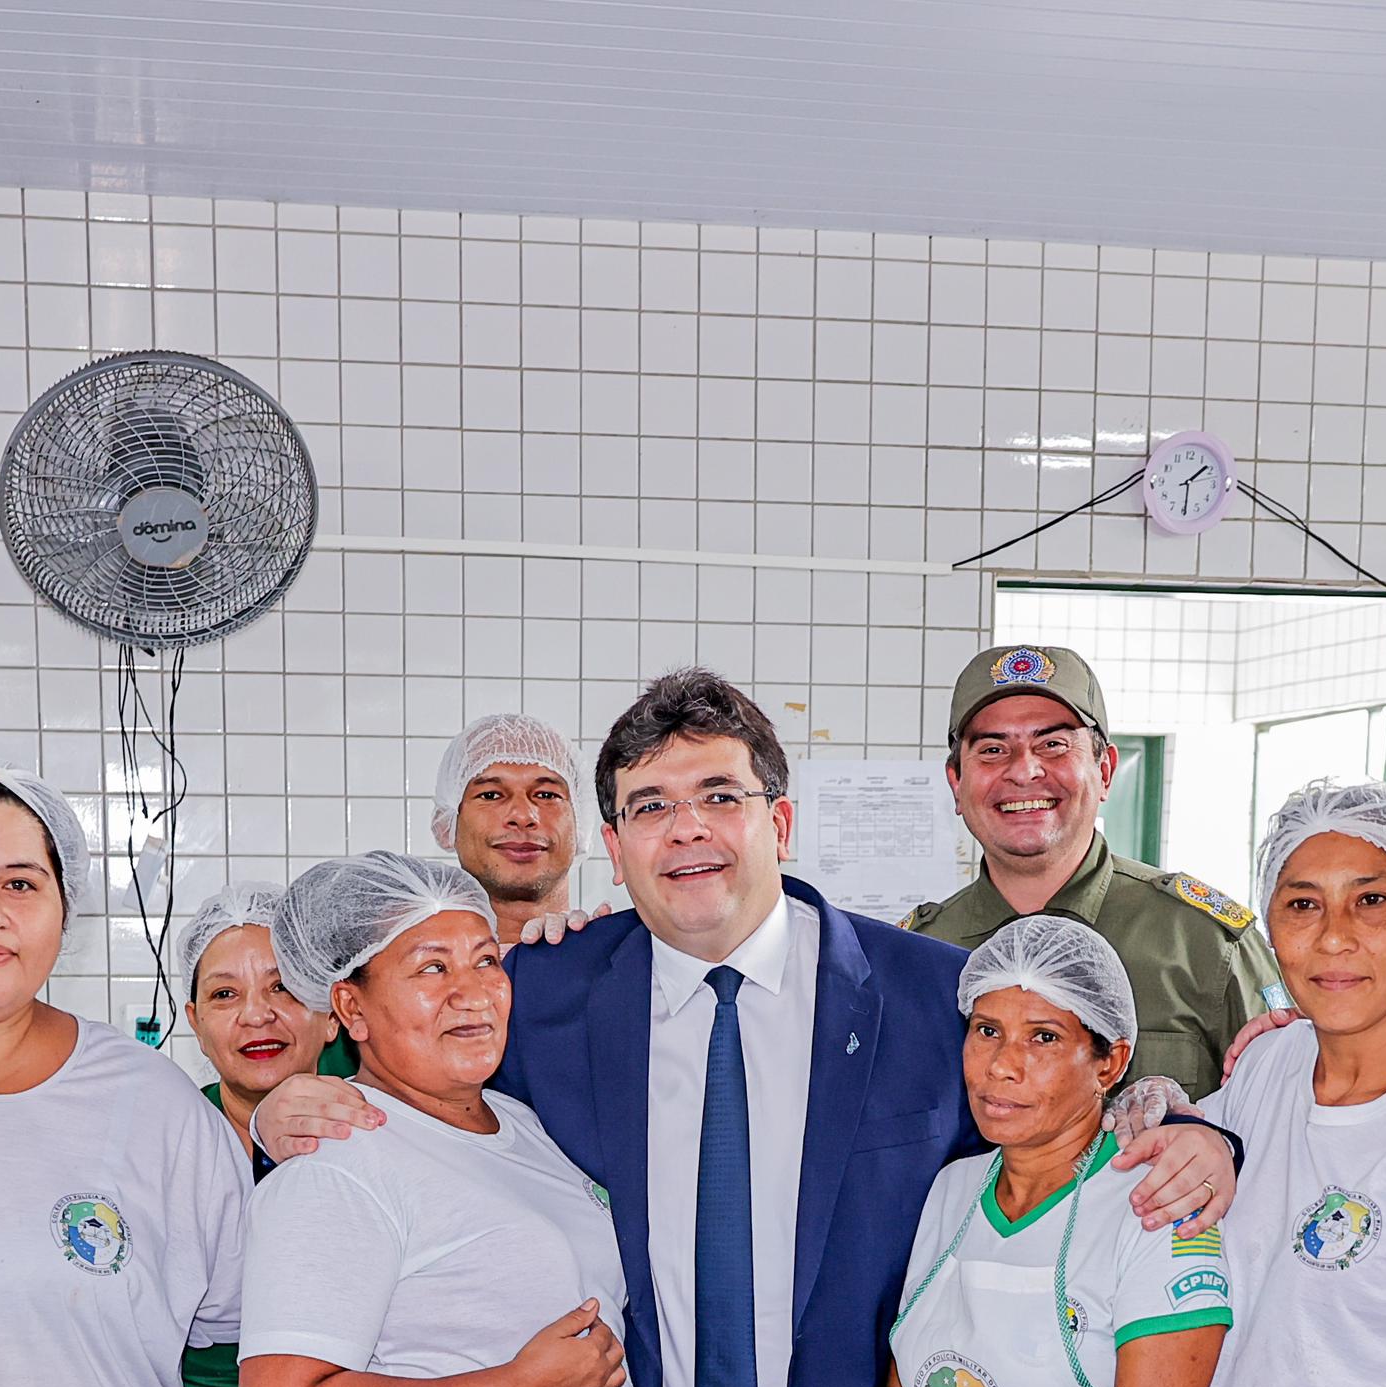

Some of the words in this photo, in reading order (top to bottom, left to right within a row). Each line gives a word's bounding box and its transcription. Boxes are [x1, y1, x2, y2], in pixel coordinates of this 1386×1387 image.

[1174, 453, 1181, 464] 11
[1186, 450, 1196, 461] 12
[1206, 465, 1214, 475] 2
[1158, 477, 1165, 487] 9
[1210, 479, 1216, 489] 3
[1169, 501, 1176, 511] 7
[1193, 503, 1201, 513] 5
[133, 519, 196, 536] dômina
[958, 1356, 987, 1378] MILITAR
